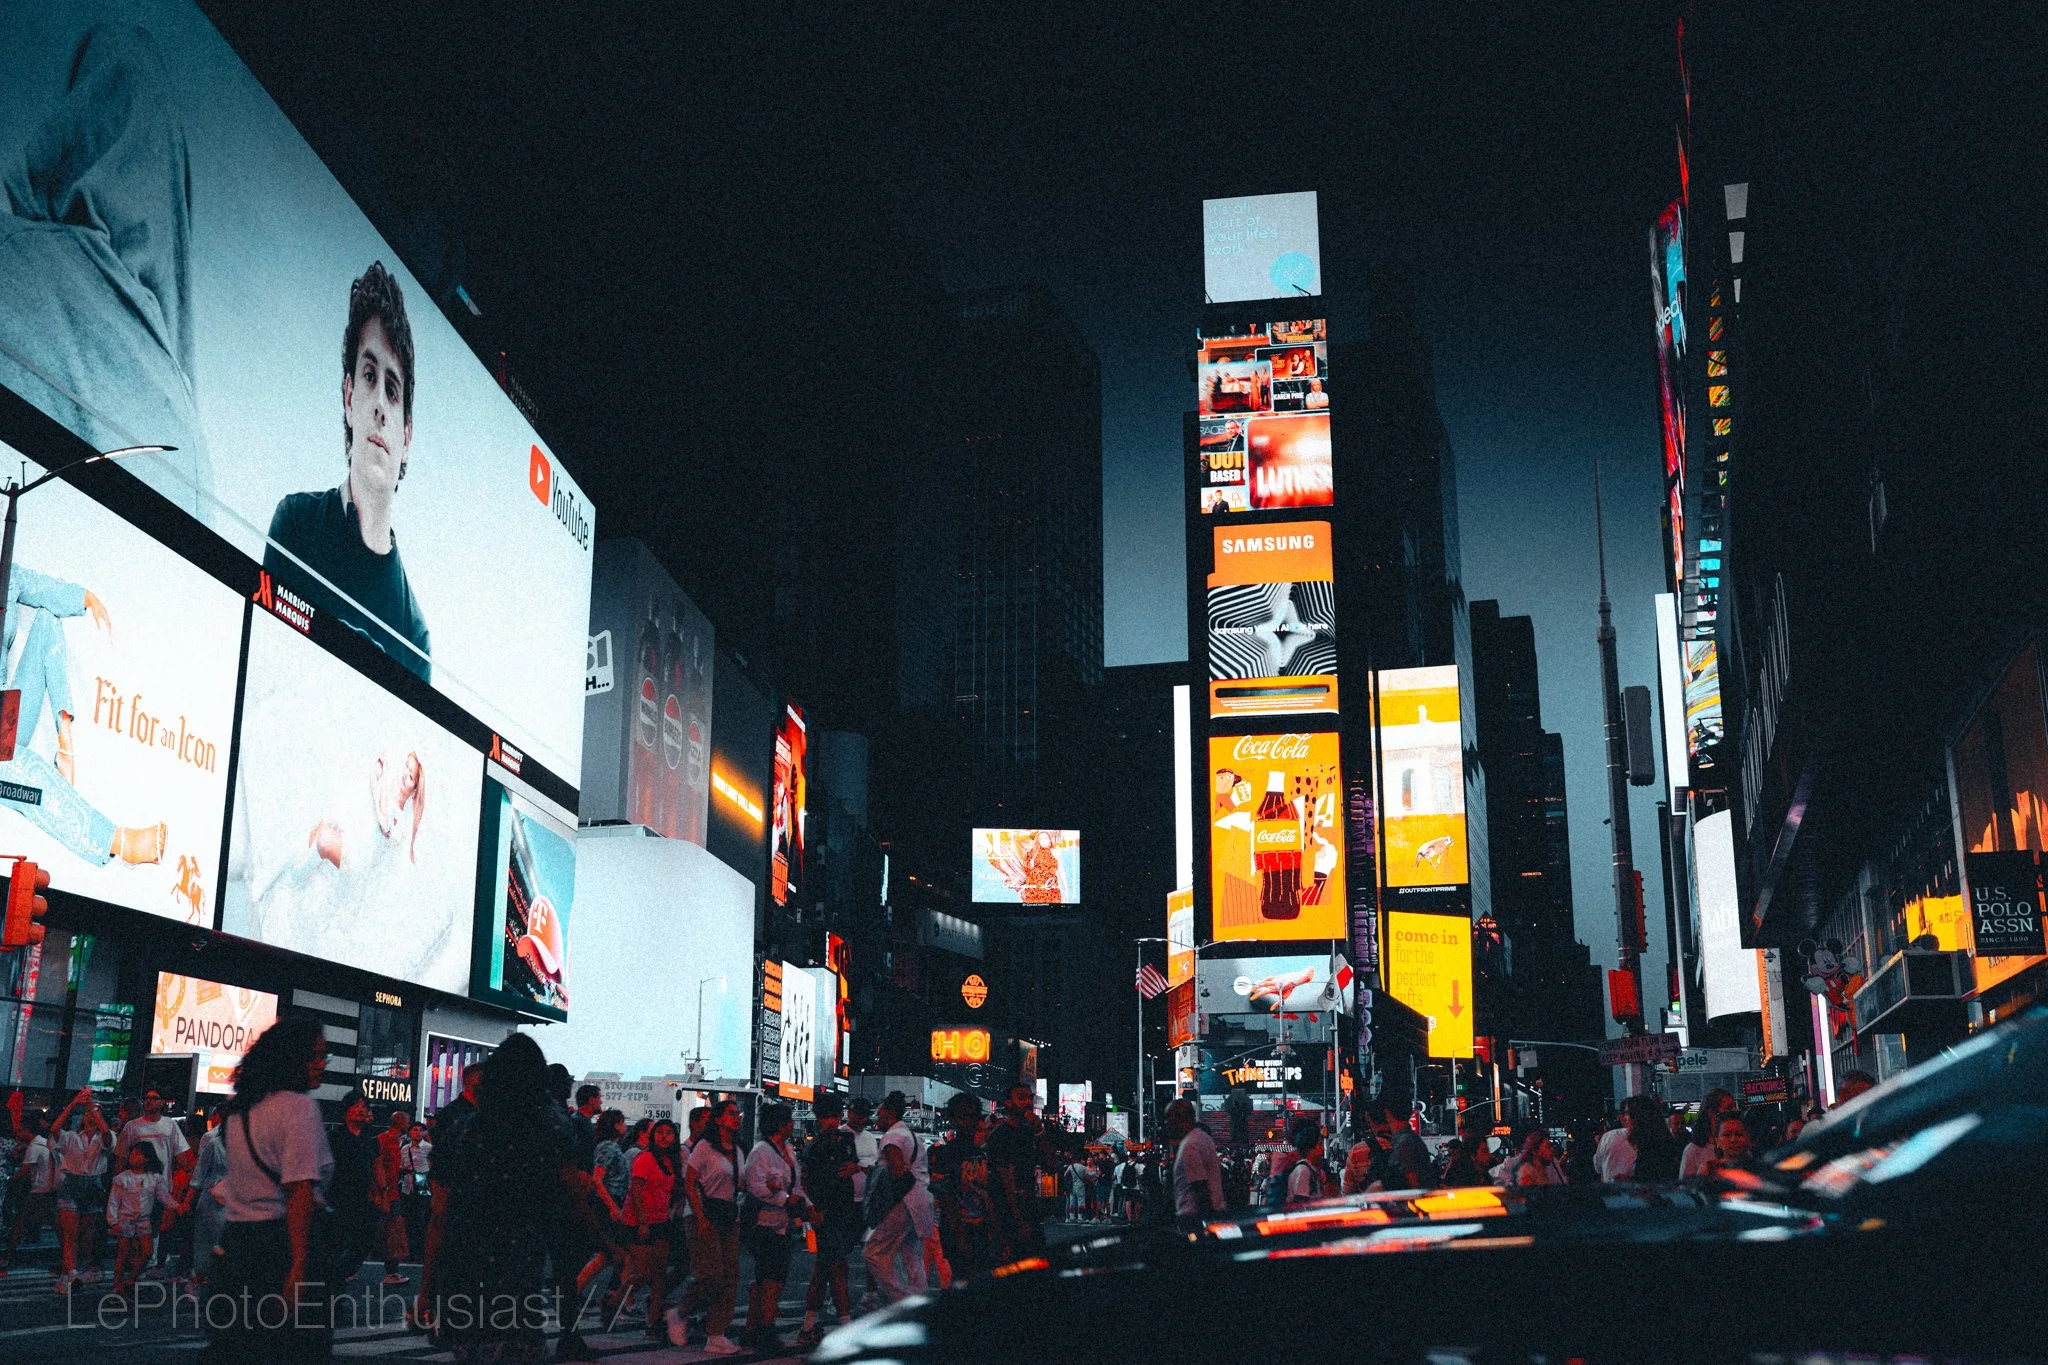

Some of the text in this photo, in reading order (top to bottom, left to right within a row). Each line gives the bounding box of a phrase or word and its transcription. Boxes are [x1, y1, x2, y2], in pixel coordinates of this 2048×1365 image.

[1210, 469, 1241, 483] BASED
[552, 470, 589, 552] YouTube
[1222, 534, 1315, 554] SAMSUNG
[277, 584, 316, 618] MARRIOTT
[275, 600, 310, 631] MARQUIS
[93, 675, 217, 774] Fit for an Icon
[0, 783, 40, 804] Broadway
[1975, 886, 2012, 902] U.S.
[1977, 901, 2032, 918] POLO
[1979, 917, 2039, 934] ASSN.
[1395, 929, 1459, 945] come in
[1395, 943, 1435, 964] for the
[1395, 967, 1438, 989] perfect
[375, 991, 402, 1008] SEPHORA
[362, 1077, 412, 1103] SEPHORA
[604, 1081, 653, 1091] STOPPERS
